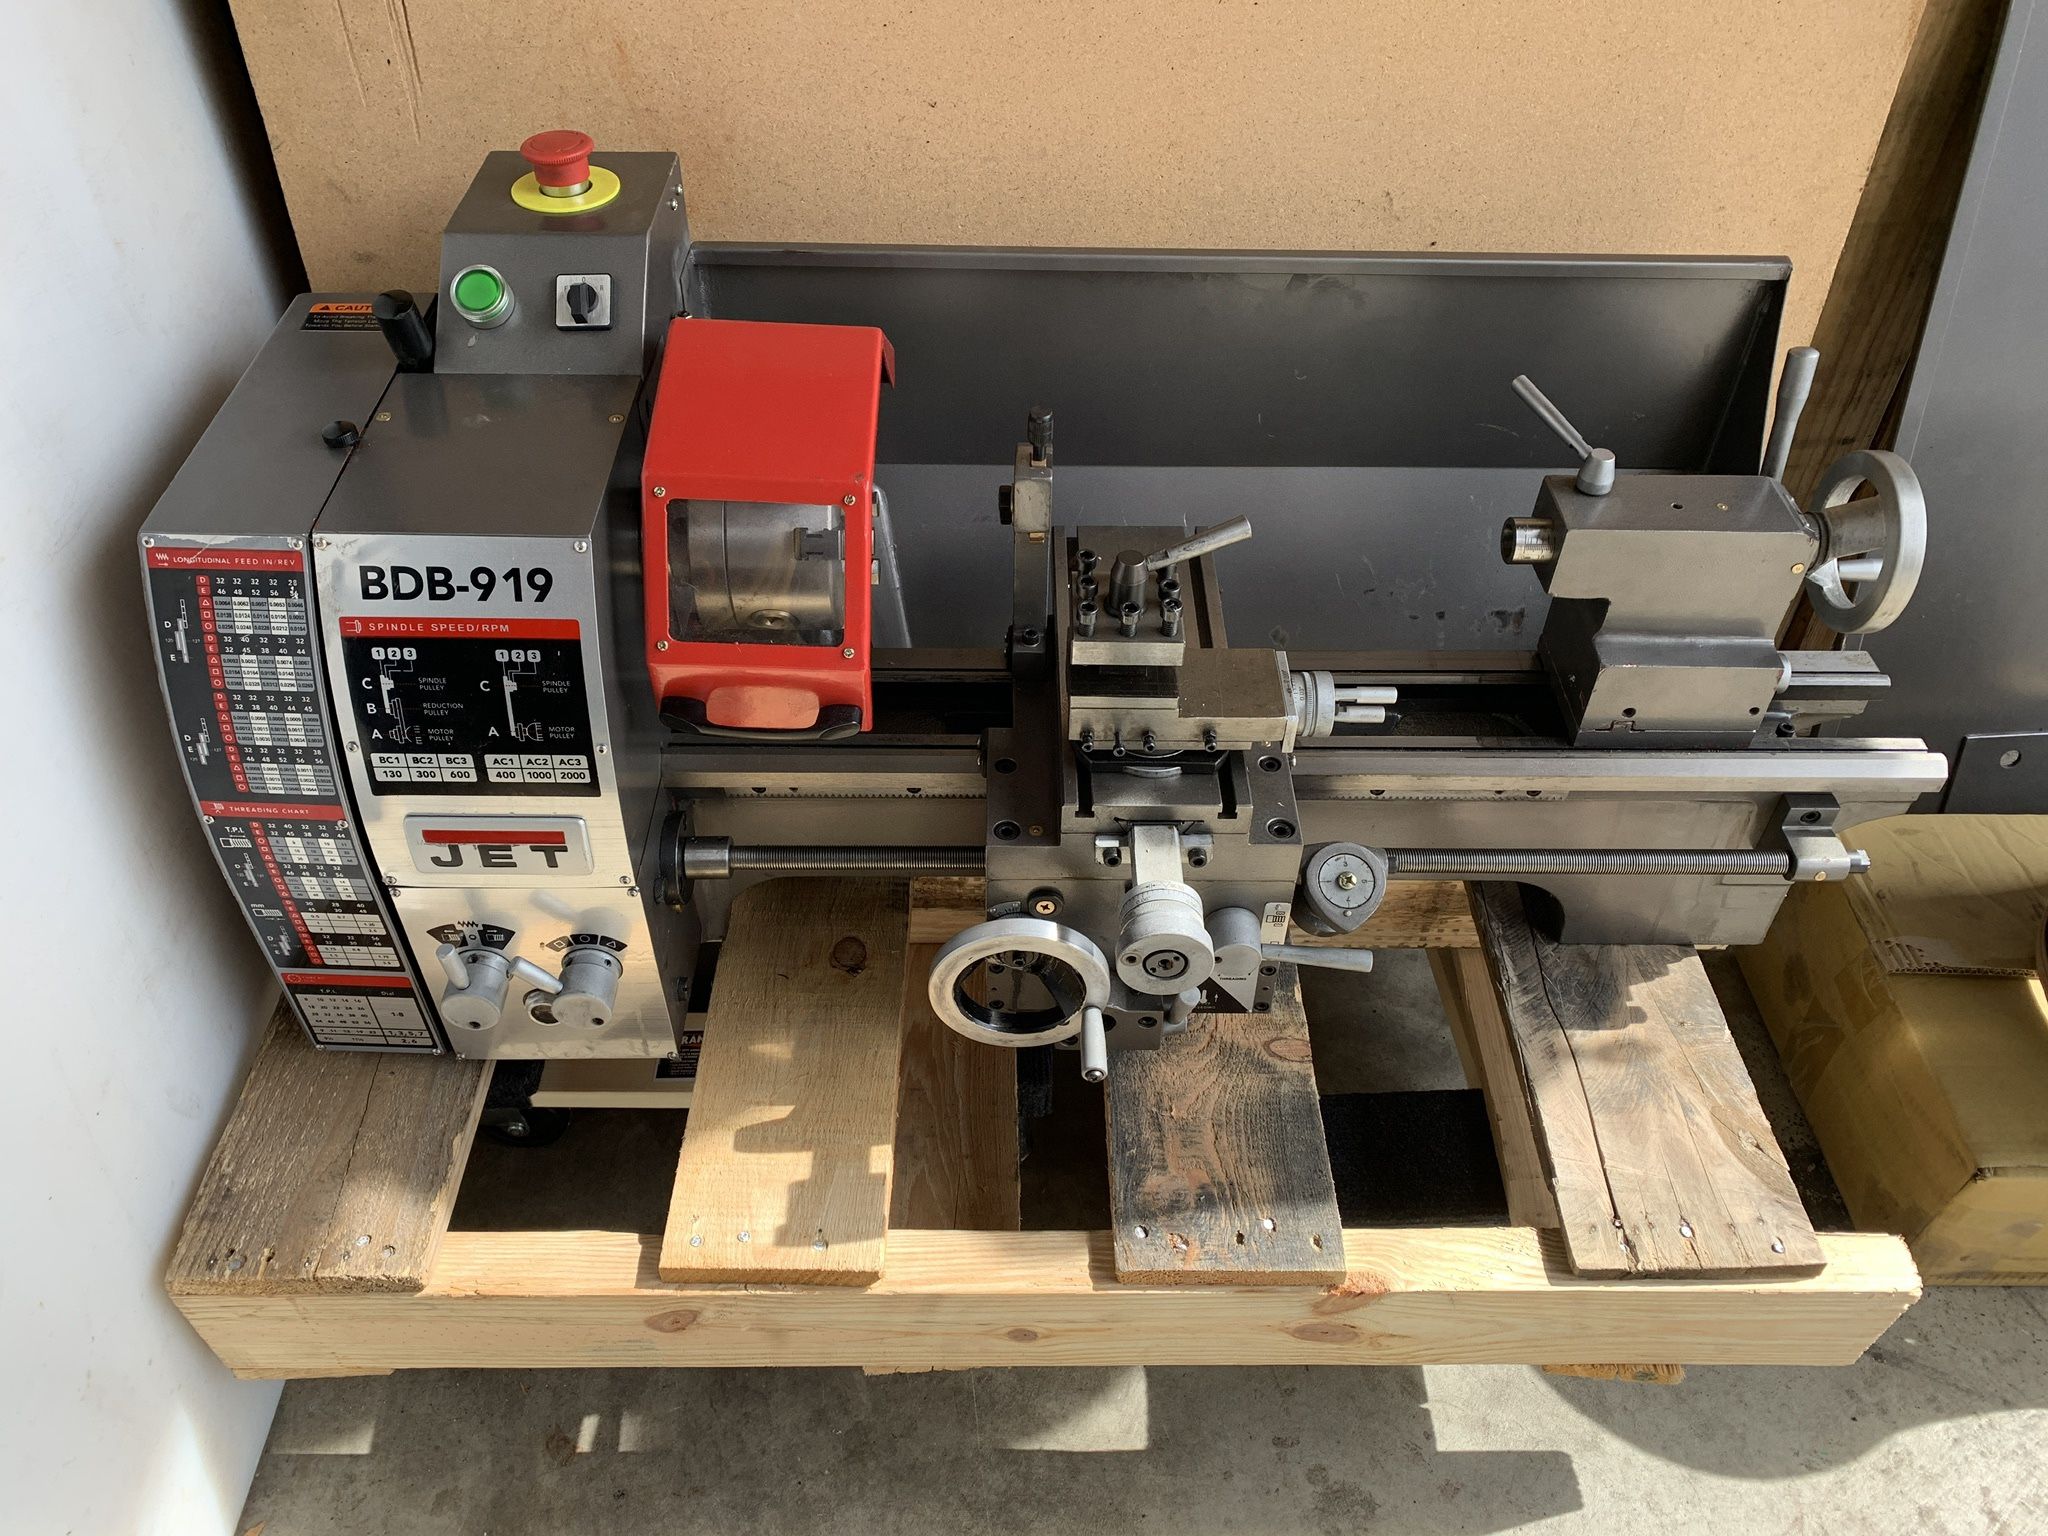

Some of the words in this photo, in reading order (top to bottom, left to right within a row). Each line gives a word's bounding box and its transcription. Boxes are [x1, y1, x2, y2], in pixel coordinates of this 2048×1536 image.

[174, 556, 230, 564] LONGITUDINAL
[359, 566, 553, 603] BDB-919
[369, 623, 424, 632] SPINDLE
[431, 623, 510, 633] SPEED/RPM
[362, 678, 373, 689] C
[480, 681, 490, 692] C
[366, 703, 377, 714] B
[372, 729, 383, 739] A
[488, 727, 500, 737] A
[526, 758, 549, 766] AC2
[561, 772, 586, 780] 2000
[229, 806, 279, 814] THREADING
[430, 844, 568, 868] JET
